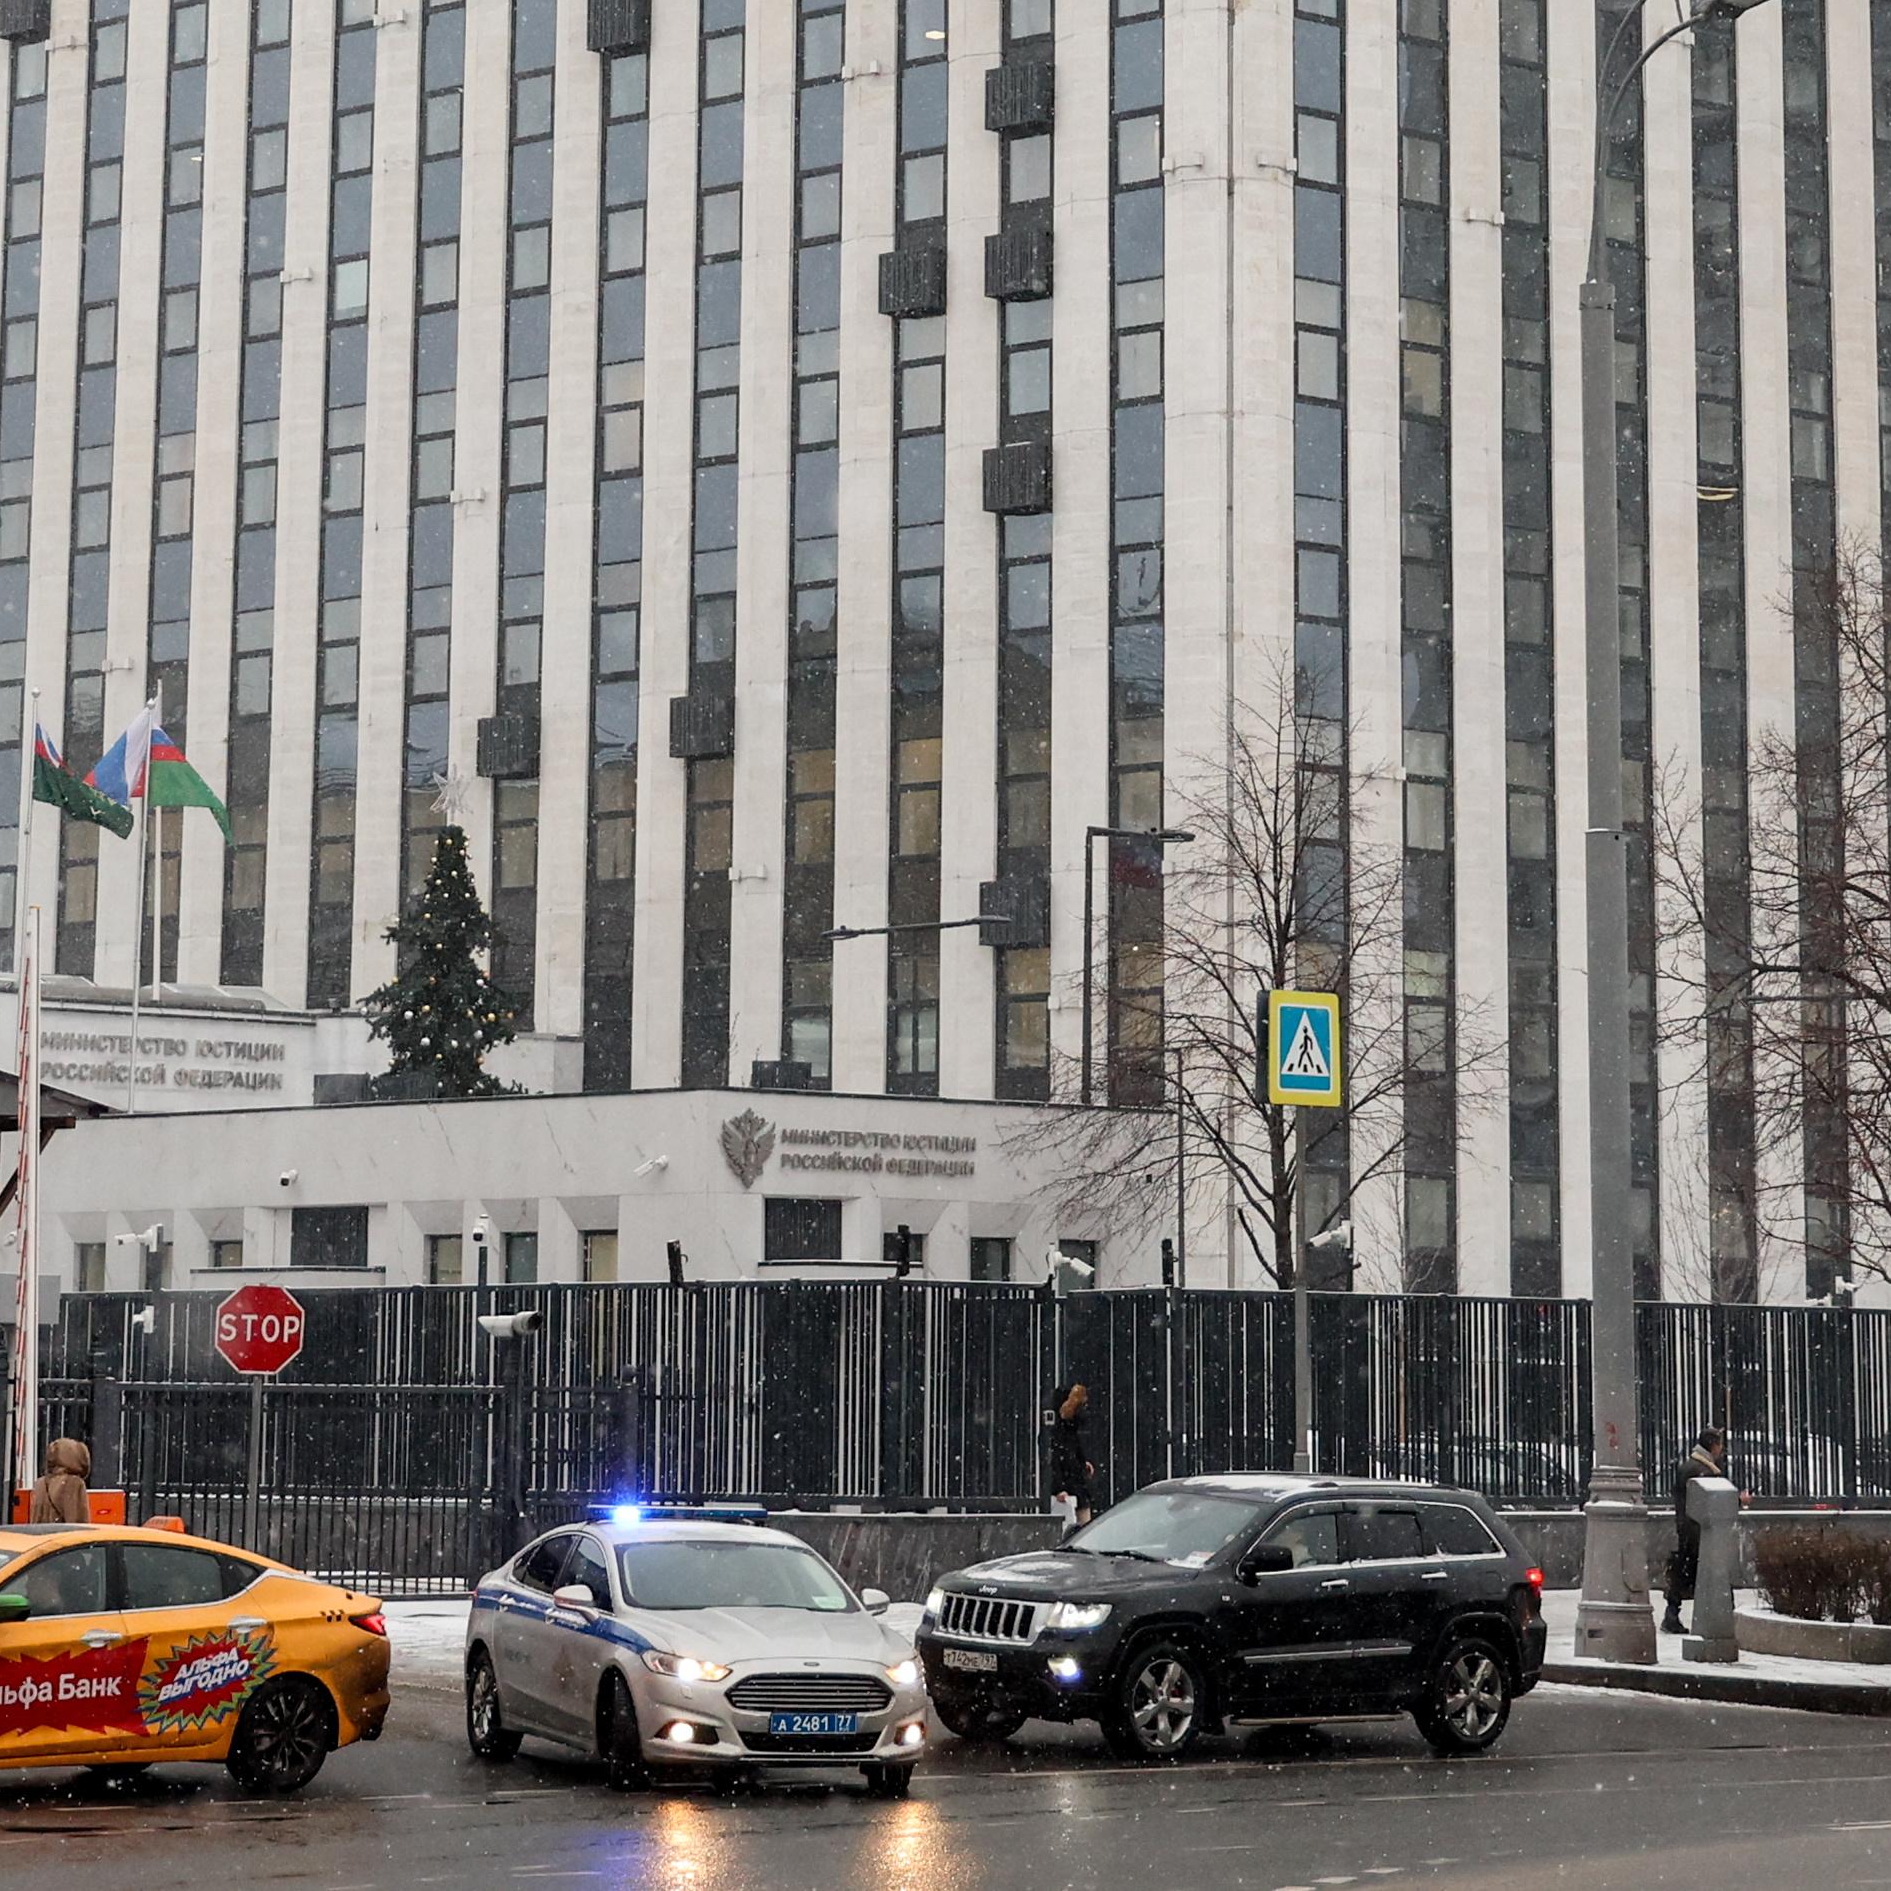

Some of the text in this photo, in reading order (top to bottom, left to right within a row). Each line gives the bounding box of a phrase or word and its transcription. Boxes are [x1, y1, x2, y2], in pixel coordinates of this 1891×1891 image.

[196, 1039, 286, 1062] ЮСТИЦИИ
[173, 1067, 284, 1091] ФЕДЕРАЦИИ
[781, 1128, 977, 1154] МИНИСТЕРСТВО ЮСТИЦИИ
[780, 1151, 975, 1178] РОССИЙСКОЙ ФЕДЕРАЦИИ
[219, 1313, 300, 1343] STOP
[978, 1584, 998, 1596] Jeep
[173, 1647, 240, 1680] АЛЬФА
[58, 1673, 122, 1700] Банк
[159, 1660, 250, 1701] ВЫГОДНО
[792, 1715, 829, 1731] 2481
